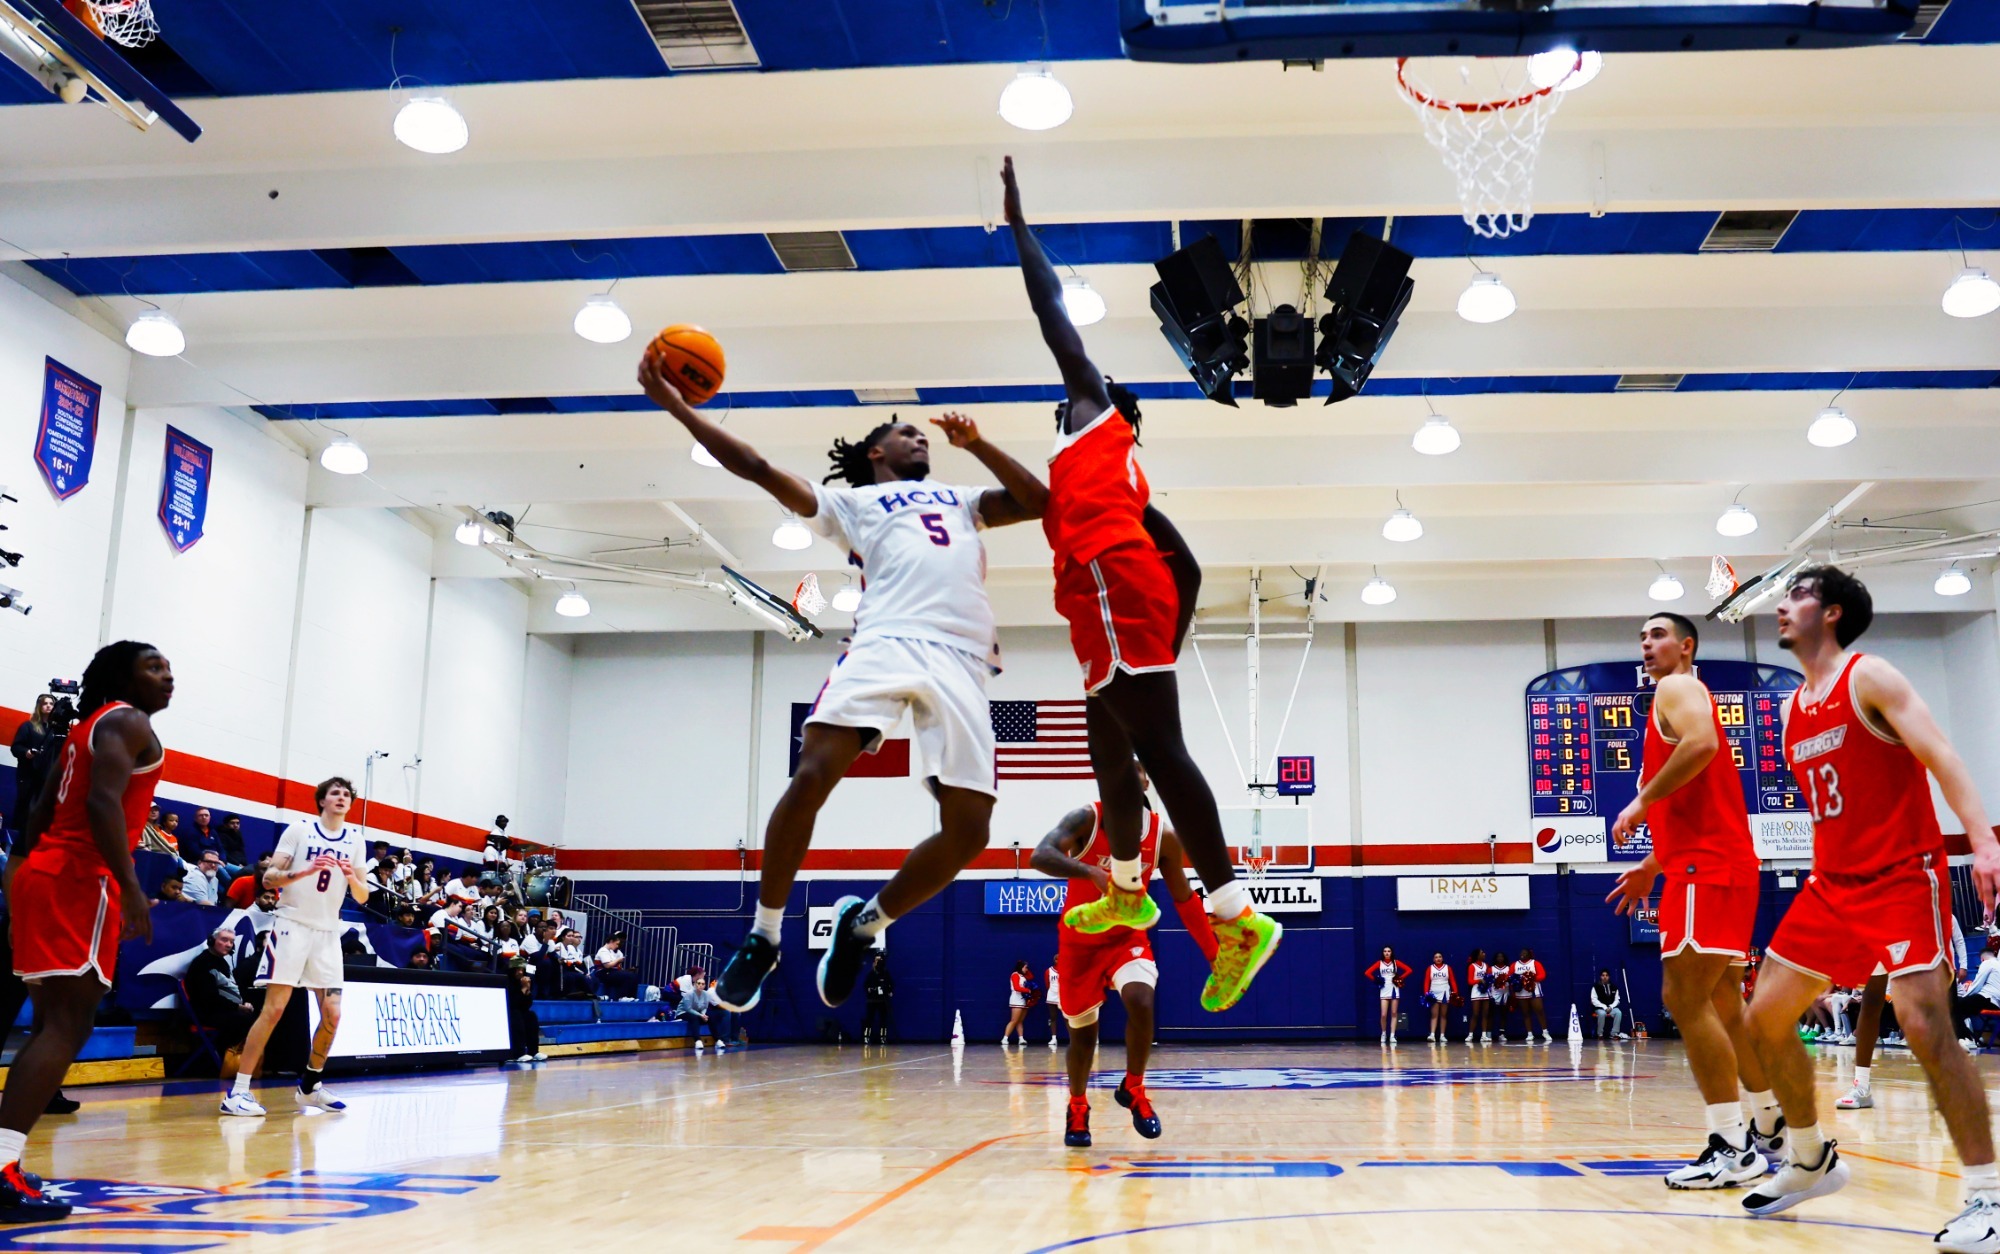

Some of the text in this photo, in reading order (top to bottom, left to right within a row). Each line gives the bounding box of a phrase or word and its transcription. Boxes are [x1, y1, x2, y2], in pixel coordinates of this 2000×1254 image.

[52, 456, 73, 475] 16-11
[878, 489, 962, 513] HCU
[919, 513, 951, 547] 5
[1593, 695, 1632, 706] HUSKIES
[1603, 707, 1631, 727] 47
[1717, 705, 1744, 726] 68
[1792, 725, 1846, 764] UTRGV
[1617, 749, 1631, 769] 5
[57, 742, 76, 805] 0
[1282, 759, 1310, 782] 20
[1766, 794, 1794, 808] TOL 2
[1806, 762, 1844, 823] 13
[1559, 797, 1587, 812] 3 TOL
[1564, 832, 1605, 847] pepsi
[316, 868, 332, 893] 8
[1430, 877, 1498, 894] IRMA'S
[1248, 886, 1317, 904] WILL.
[375, 992, 460, 1021] MEMORIAL
[376, 1018, 461, 1047] HERMANN
